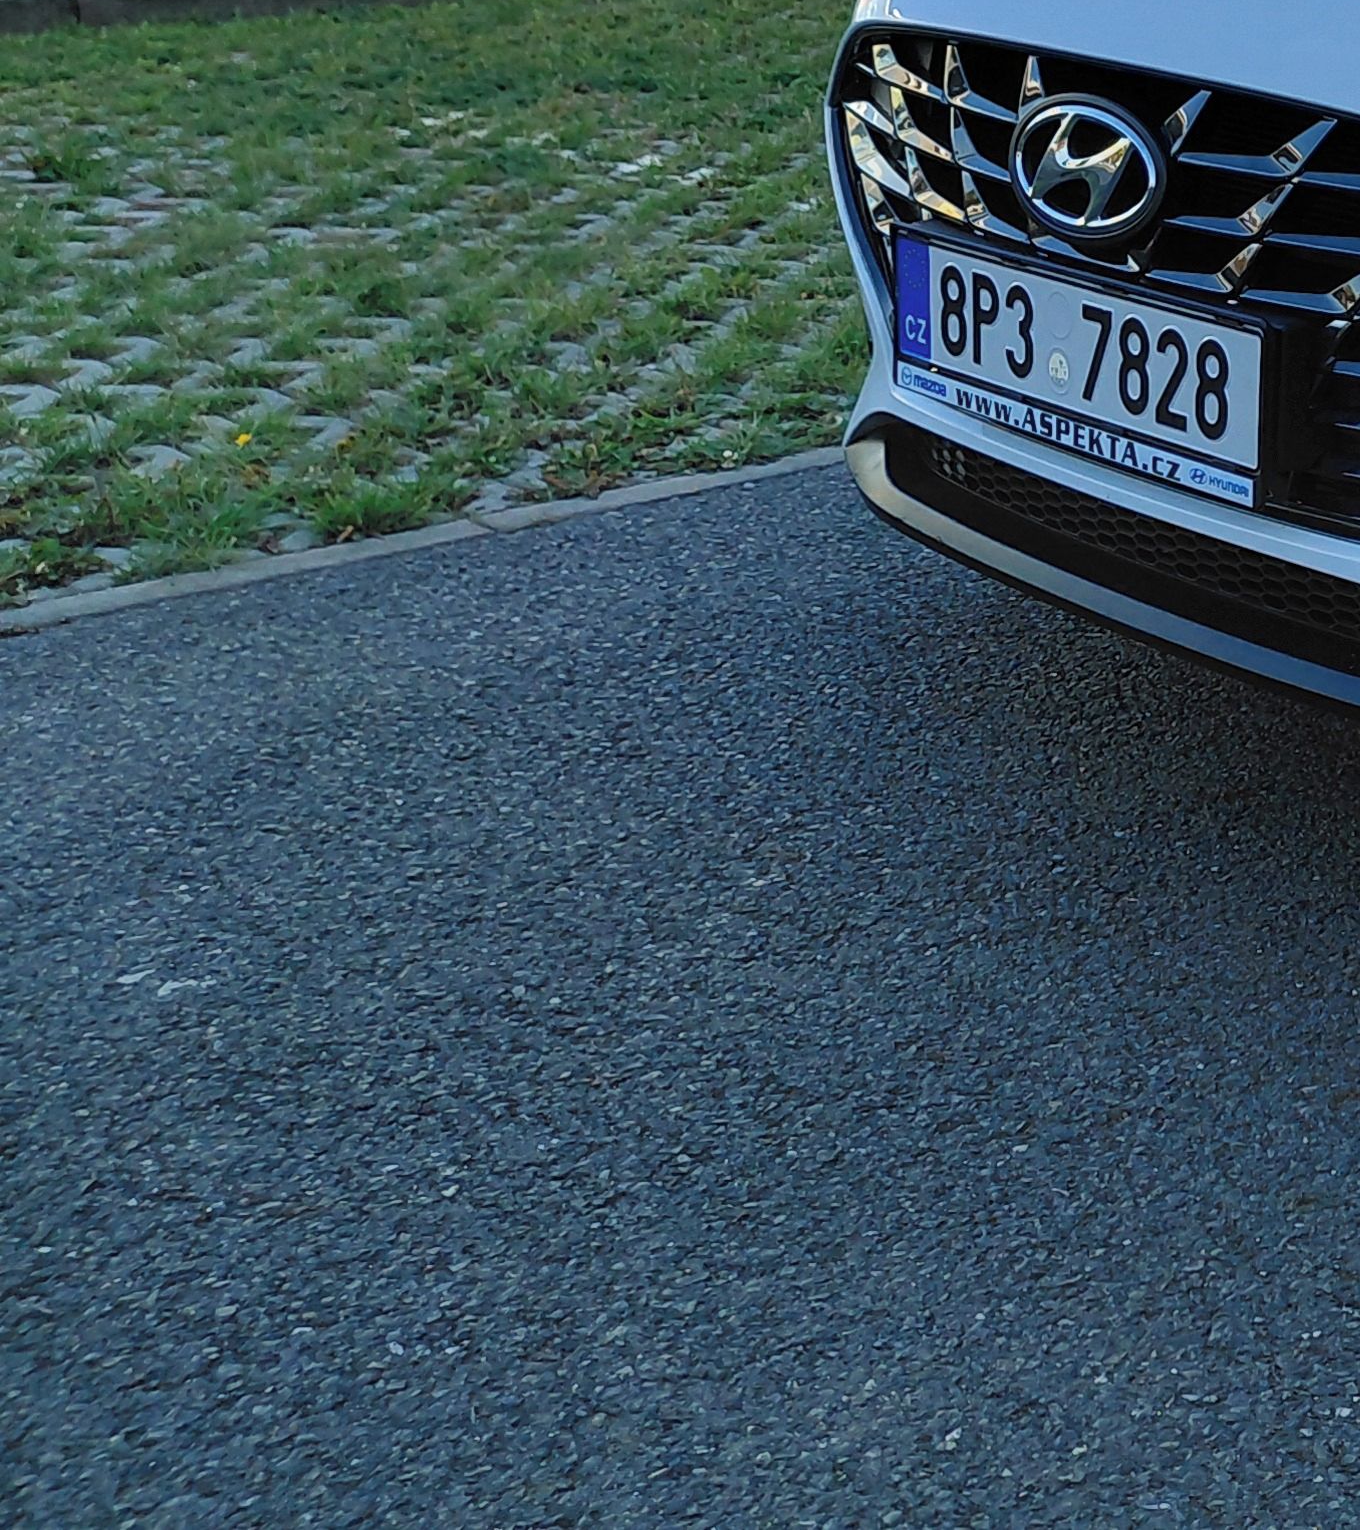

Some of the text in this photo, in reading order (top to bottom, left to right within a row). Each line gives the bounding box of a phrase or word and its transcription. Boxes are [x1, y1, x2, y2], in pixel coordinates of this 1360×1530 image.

[905, 314, 926, 344] CZ
[940, 265, 1228, 440] 8P3 7828
[1209, 476, 1249, 498] HYUNDAI
